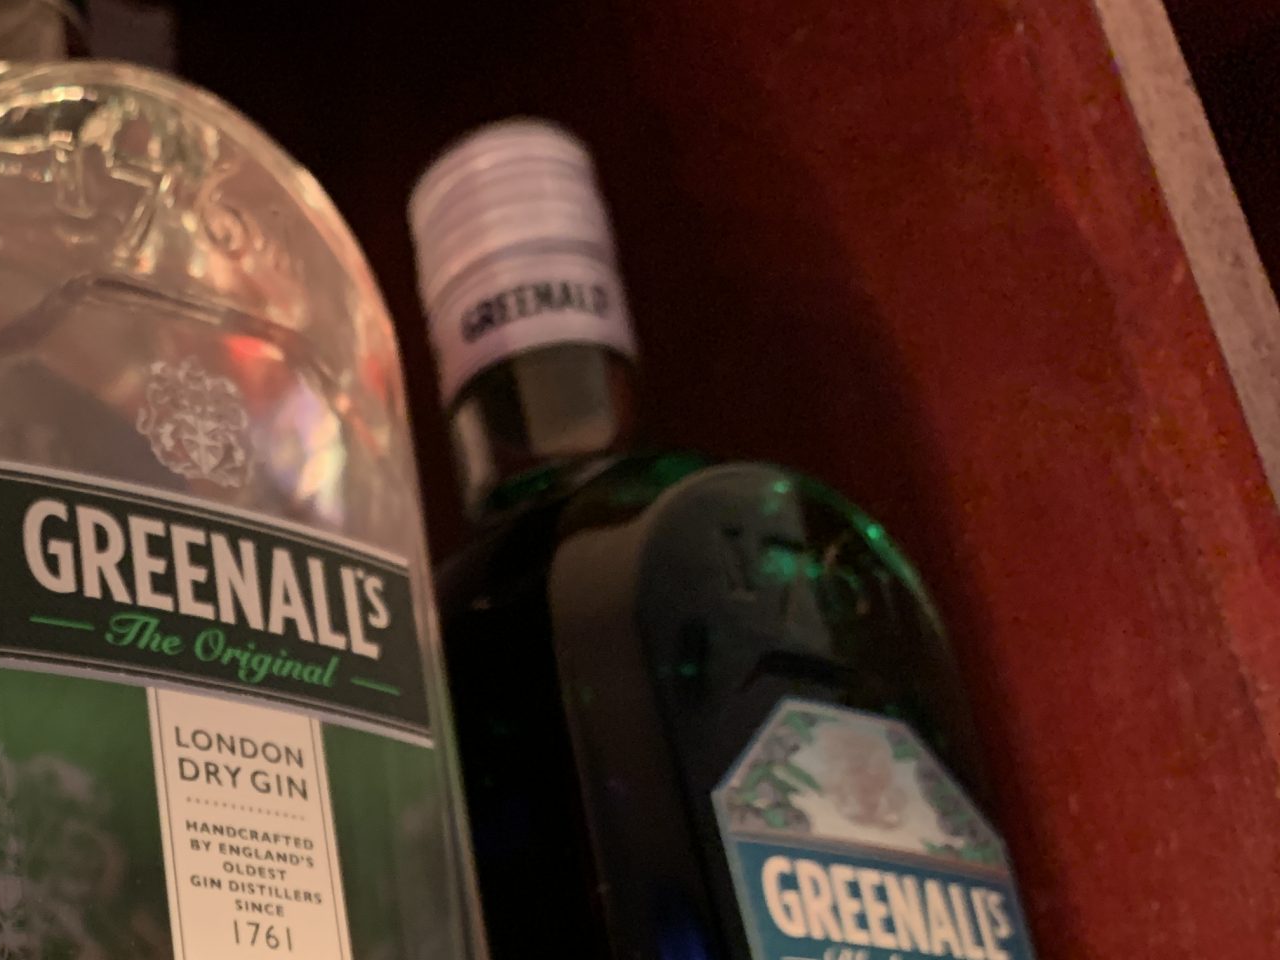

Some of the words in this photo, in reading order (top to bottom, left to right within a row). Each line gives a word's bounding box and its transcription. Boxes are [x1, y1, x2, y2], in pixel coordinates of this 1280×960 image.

[105, 611, 184, 656] The
[194, 628, 341, 688] Original
[174, 726, 305, 768] LONDON
[178, 757, 242, 788] DRY
[250, 770, 309, 801] GIN
[185, 820, 314, 851] HANDCRAFTED
[190, 839, 213, 852] BY
[219, 844, 315, 869] ENGLAND'S
[222, 860, 287, 882] OLDEST
[190, 874, 222, 891] GIN
[228, 879, 322, 905] DISTILLERS
[234, 898, 285, 918] SINCE
[232, 919, 293, 953] 1761
